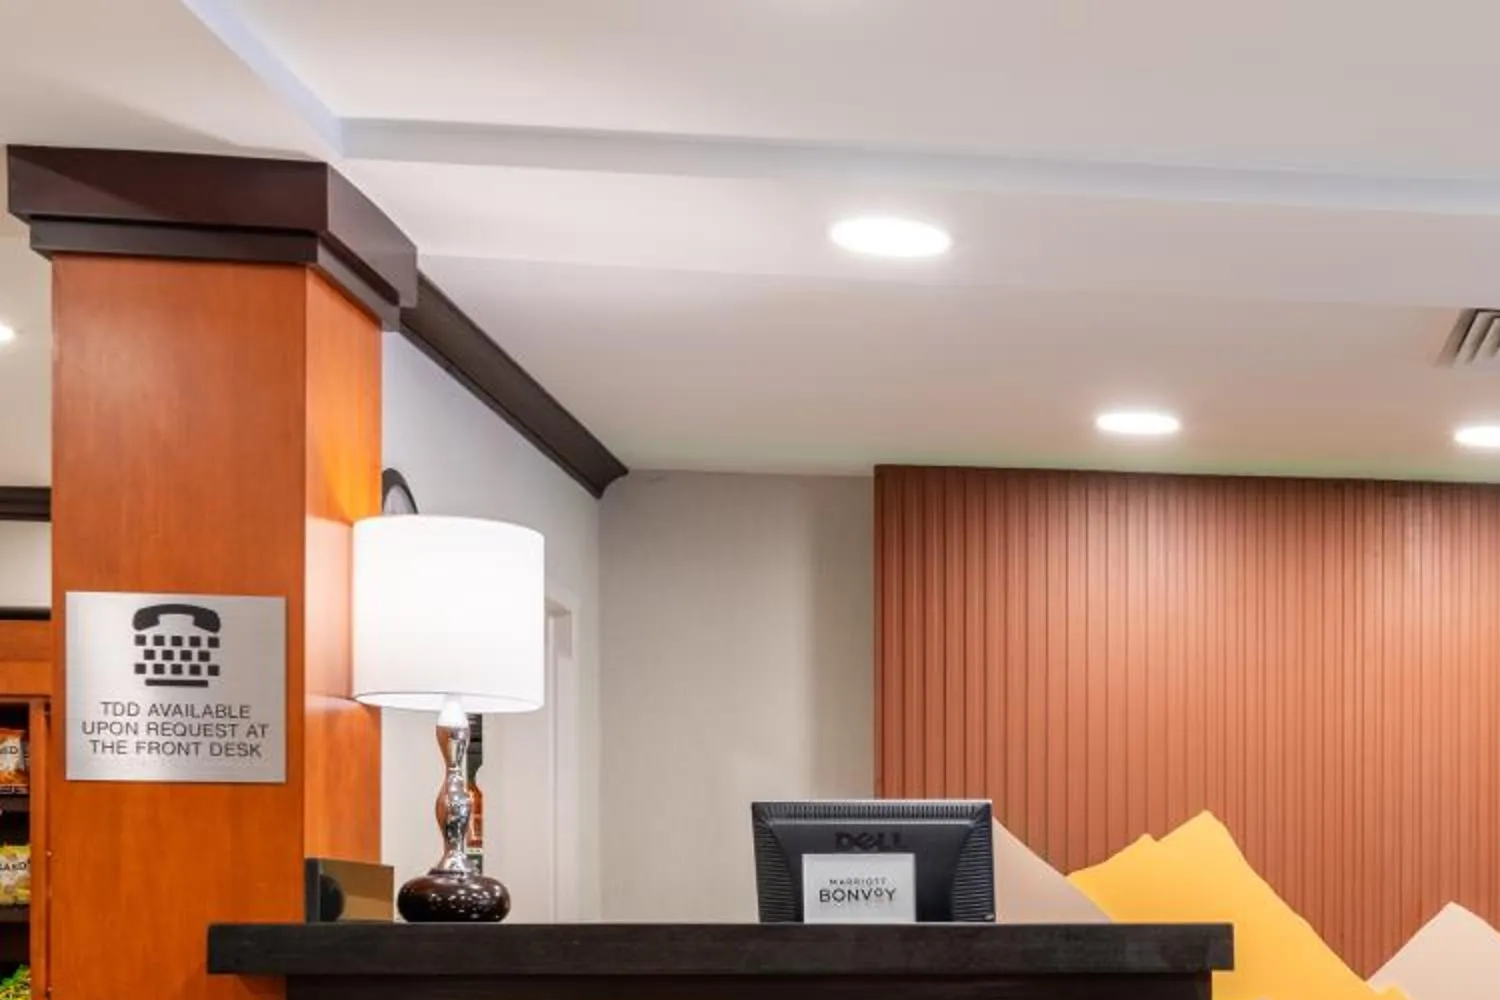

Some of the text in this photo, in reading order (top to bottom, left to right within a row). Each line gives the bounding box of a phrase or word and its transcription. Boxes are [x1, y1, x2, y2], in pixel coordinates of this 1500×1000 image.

[101, 701, 251, 719] TDD AVAILABLE
[82, 721, 269, 739] UPON REQUEST AT
[90, 739, 262, 758] THE FRONT DESK
[829, 877, 886, 885] MARRIOTT
[819, 887, 896, 903] BONVOY
